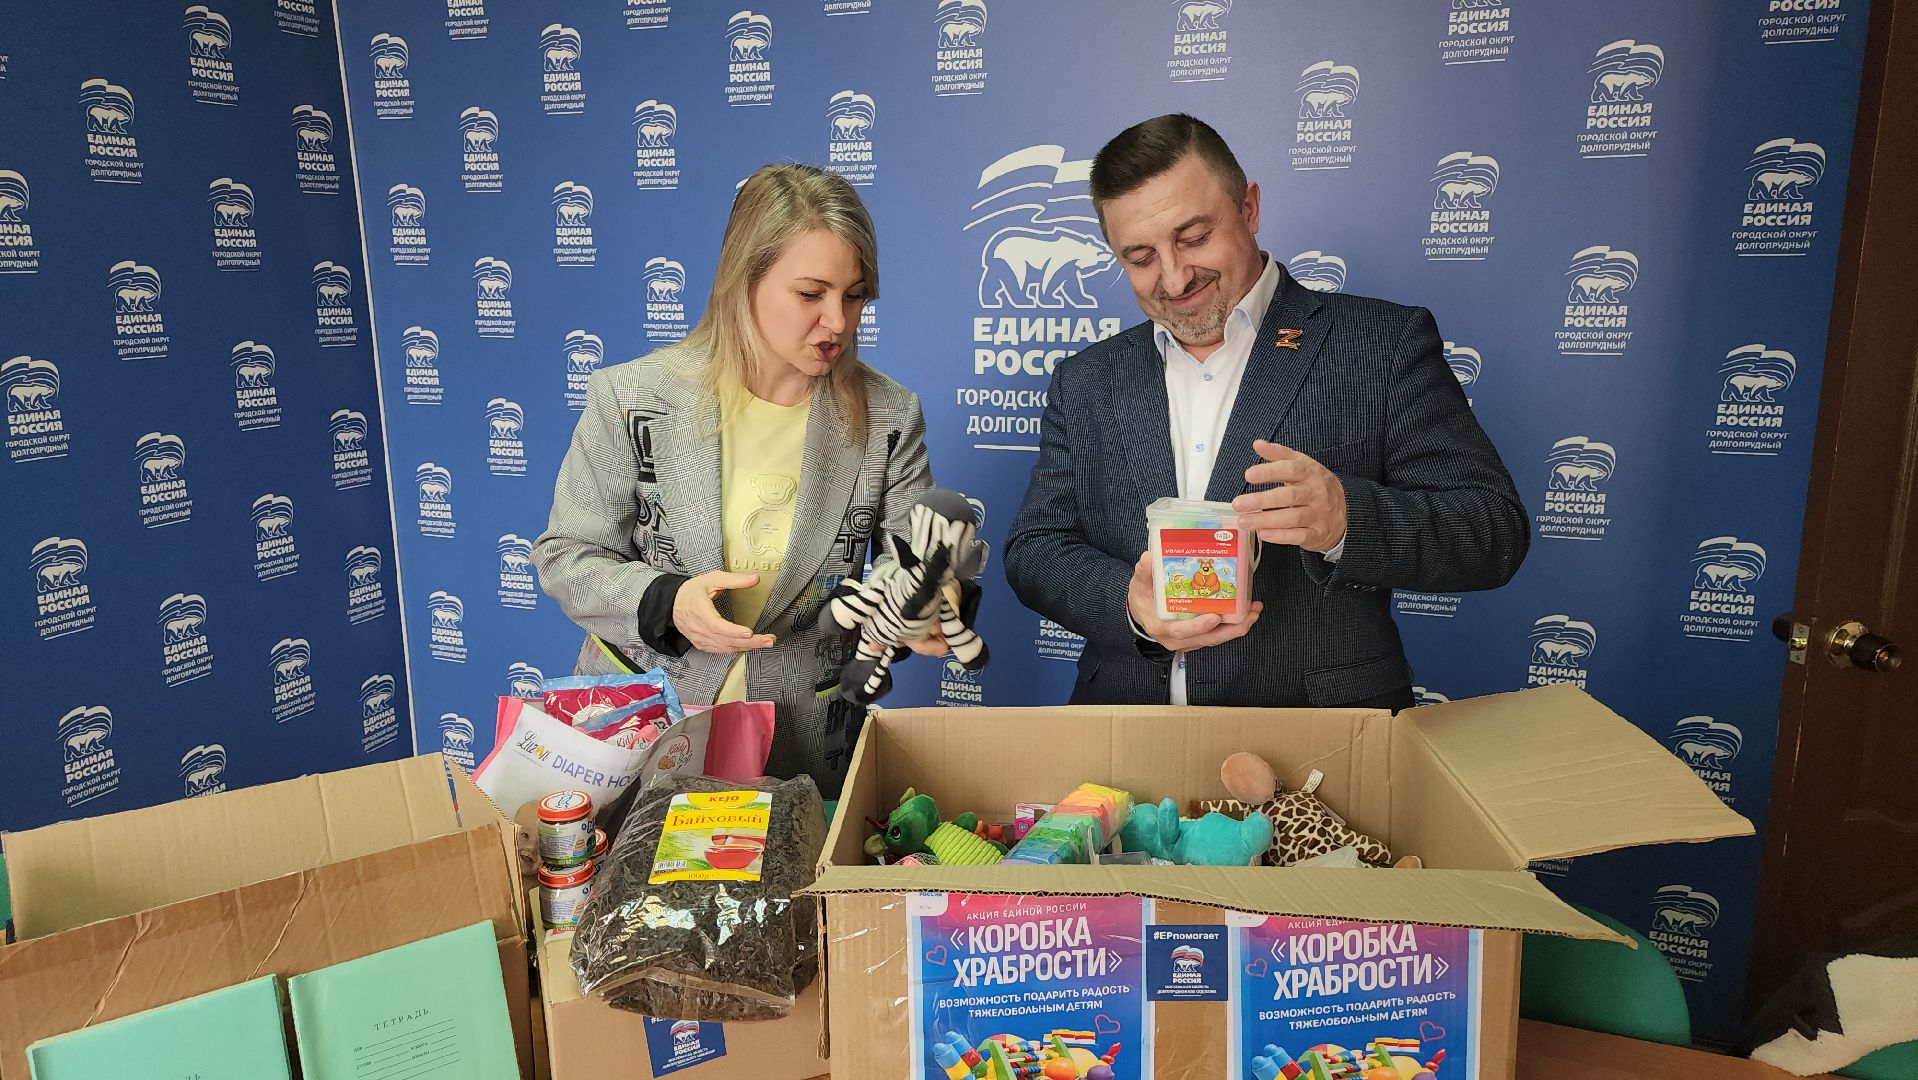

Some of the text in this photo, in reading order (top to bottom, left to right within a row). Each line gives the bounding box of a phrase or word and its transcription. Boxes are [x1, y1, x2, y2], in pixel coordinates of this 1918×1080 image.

[1449, 8, 1510, 23] ЕДИНАЯ
[1758, 13, 1847, 26] ГОРОДСКОЙ ОКРУГ
[1448, 21, 1509, 35] РОССИЯ
[1761, 25, 1839, 38] ДОЛГОПРУДНЫЙ
[1174, 31, 1227, 44] ЕДИНАЯ
[1438, 35, 1516, 48] ГОРОДСКОЙ ОКРУГ
[937, 48, 982, 60] ЕДИНАЯ
[1174, 43, 1226, 55] РОССИЯ
[1441, 46, 1509, 60] ДОЛГОПРУДНЫЙ
[729, 62, 770, 73] ЕДИНАЯ
[937, 59, 983, 70] РОССИЯ
[543, 72, 580, 82] ЕДИНАЯ
[730, 72, 770, 82] РОССИЯ
[931, 72, 988, 82] ГОРОДСКОЙ ОКРУГ
[544, 82, 581, 92] РОССИЯ
[934, 81, 985, 92] ДОЛГОПРУДНЫЙ
[1587, 103, 1652, 117] ЕДИНАЯ
[1297, 119, 1352, 132] ЕДИНАЯ
[1586, 116, 1651, 129] РОССИЯ
[87, 134, 136, 146] ЕДИНАЯ
[1296, 131, 1351, 142] РОССИЯ
[1576, 131, 1658, 142] ГОРОДСКОЙ ОКРУГ
[89, 145, 138, 157] РОССИЯ
[830, 142, 872, 152] ЕДИНАЯ
[1288, 146, 1332, 155] ГОРОДСКОЙ
[1579, 142, 1650, 153] ДОЛГОПРУДНЫЙ
[830, 152, 872, 162] РОССИЯ
[1291, 155, 1352, 166] ДОЛГОПРУДНЫЙ
[1744, 202, 1813, 214] ЕДИНАЯ
[1431, 211, 1490, 222] ЕДИНАЯ
[1742, 215, 1812, 226] РОССИЯ
[214, 229, 255, 238] ЕДИНАЯ
[556, 228, 592, 236] ЕДИНАЯ
[1430, 222, 1489, 233] РОССИЯ
[557, 236, 593, 245] РОССИЯ
[1421, 236, 1495, 246] ГОРОДСКОЙ ОКРУГ
[1731, 231, 1818, 239] ГОРОДСКОЙ ОКРУГ
[216, 238, 257, 248] РОССИЯ
[1734, 242, 1810, 251] ДОЛГОПРУДНЫЙ
[1424, 246, 1489, 256] ДОЛГОПРУДНЫЙ
[1565, 305, 1628, 316] ЕДИНАЯ
[115, 314, 162, 324] ЕДИНАЯ
[1564, 317, 1626, 328] РОССИЯ
[117, 324, 163, 334] РОССИЯ
[974, 318, 1120, 345] ЕДИНАЯ
[1554, 331, 1633, 340] ГОРОДСКОЙ ОКРУГ
[1557, 341, 1626, 350] ДОЛГОПРУДНЫЙ
[975, 349, 1078, 376] РОСС
[236, 387, 276, 399] ЕДИНАЯ
[238, 397, 277, 408] РОССИЯ
[1717, 404, 1784, 415] ЕДИНАЯ
[7, 410, 61, 424] ЕДИНАЯ
[1716, 416, 1782, 427] РОССИЯ
[10, 421, 63, 436] РОССИЯ
[966, 416, 1040, 434] ДОЛГОП
[1706, 430, 1759, 438] ГОРОДСКОЙ
[5, 433, 70, 448] ГОРОДСКОЙ ОКРУГ
[489, 440, 523, 448] ЕДИНАЯ
[1708, 440, 1782, 449] ДОЛГОПРУДНЫЙ
[10, 443, 69, 458] ДОЛГОПРУДНЫЙ
[490, 447, 524, 457] РОССИЯ
[140, 480, 186, 494] ЕДИНАЯ
[142, 489, 187, 504] РОССИЯ
[1545, 492, 1606, 503] ЕДИНАЯ
[1544, 502, 1605, 514] РОССИЯ
[1535, 515, 1612, 526] ГОРОДСКОЙ ОКРУГ
[1539, 525, 1605, 535] ДОЛГОПРУДНЫЙ
[37, 585, 88, 604] ЕДИНАЯ
[1690, 591, 1755, 604] ЕДИНАЯ
[39, 595, 90, 615] РОССИЯ
[1689, 602, 1754, 615] РОССИЯ
[1680, 614, 1760, 627] ГОРОДСКОЙ ОКРУГ
[1682, 624, 1754, 636] ДОЛГОПРУДНЫЙ
[163, 636, 207, 655] ЕДИНАЯ
[165, 645, 208, 665] РОССИЯ
[654, 721, 668, 730] 12
[64, 749, 113, 773] ЕДИНАЯ
[66, 758, 115, 783] РОССИЯ
[552, 754, 604, 786] DIAPER
[672, 815, 762, 826] Байховый
[966, 902, 1087, 920] АКЦИЯ ЕДИНОЙ РОССИИ
[1288, 918, 1322, 929] АКЦИЯ
[950, 916, 1092, 954] «КОРОБКА
[1154, 931, 1219, 940] #ЕРпомогает
[1270, 924, 1418, 966] «КОРОБКА
[953, 948, 1122, 988] ХРАБРОСТИ»
[1273, 953, 1449, 1000] ХРАБРОСТИ»
[939, 985, 1129, 1009] ВОЗМОЖНОСТЬ ПОДАРИТЬ РАДОСТЬ
[968, 1000, 1103, 1018] ТЯЖЕЛОБОЛЬНЫМ ДЕТЯМ
[1258, 991, 1456, 1021] ВОЗМОЖНОСТЬ ПОДАРИТЬ РАДОСТЬ
[374, 1008, 429, 1030] ТЕТРАДЬ
[1289, 1007, 1428, 1031] ТЯЖЕЛОБОЛЬНЫМ ДЕТЯМ
